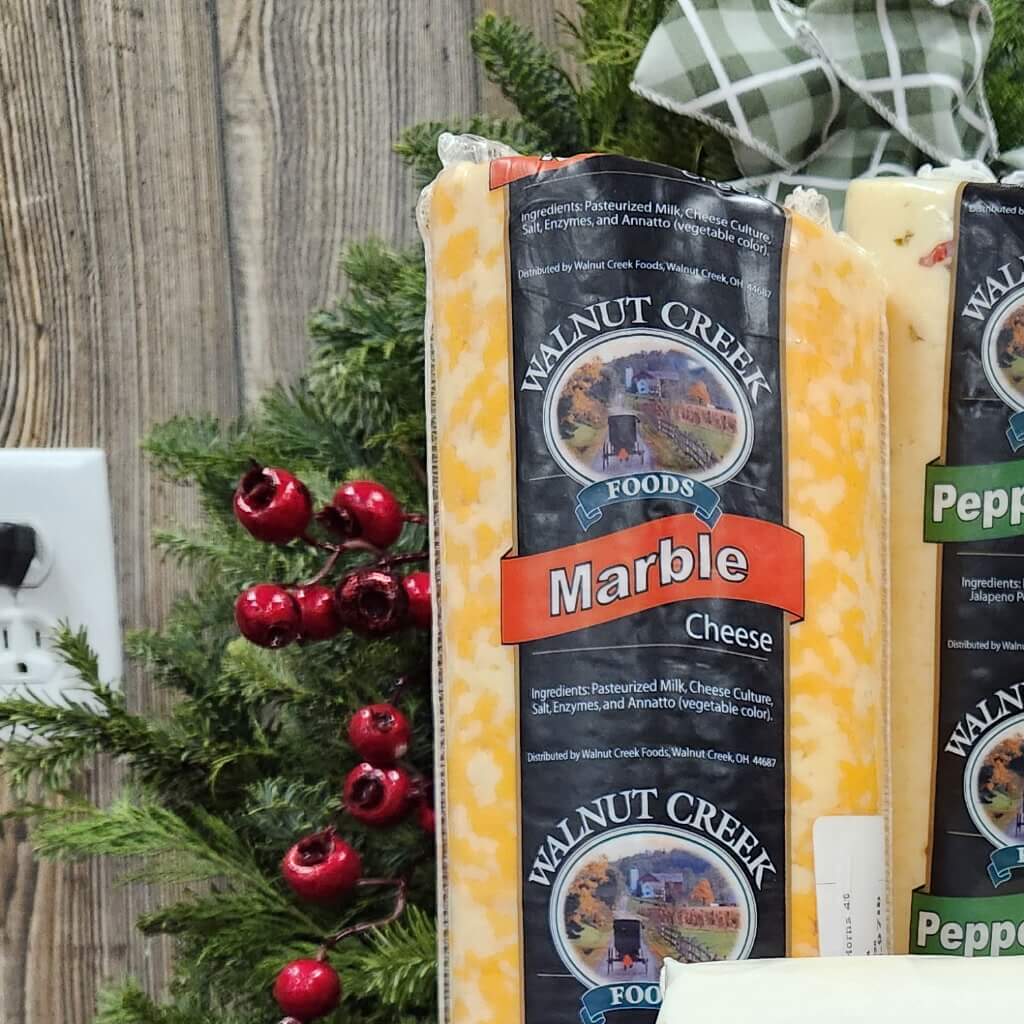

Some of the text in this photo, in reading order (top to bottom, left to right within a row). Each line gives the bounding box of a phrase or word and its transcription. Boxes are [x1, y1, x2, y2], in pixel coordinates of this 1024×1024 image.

[520, 296, 772, 404] WALNUT CREEK
[607, 475, 695, 499] FOODS
[549, 532, 748, 617] Marble
[961, 577, 1021, 591] Ingredients:
[969, 591, 1015, 605] Jalapeno
[685, 613, 773, 651] Cheese
[531, 679, 774, 706] Ingredients: Pasteurized Milk, Cheese Culture,
[553, 700, 601, 716] Enzymes,
[603, 697, 624, 709] and
[628, 697, 675, 710] Annatto
[679, 698, 739, 716] (vegetable
[741, 707, 773, 722] color).
[528, 751, 568, 762] Distributed
[570, 750, 580, 761] by
[582, 749, 612, 759] Walnut
[614, 748, 639, 758] Creek
[672, 747, 704, 758] Walnut
[736, 754, 749, 765] OH
[752, 757, 777, 768] 44687
[528, 788, 776, 891] WALNUT CREEK
[610, 986, 663, 1006] FOO
